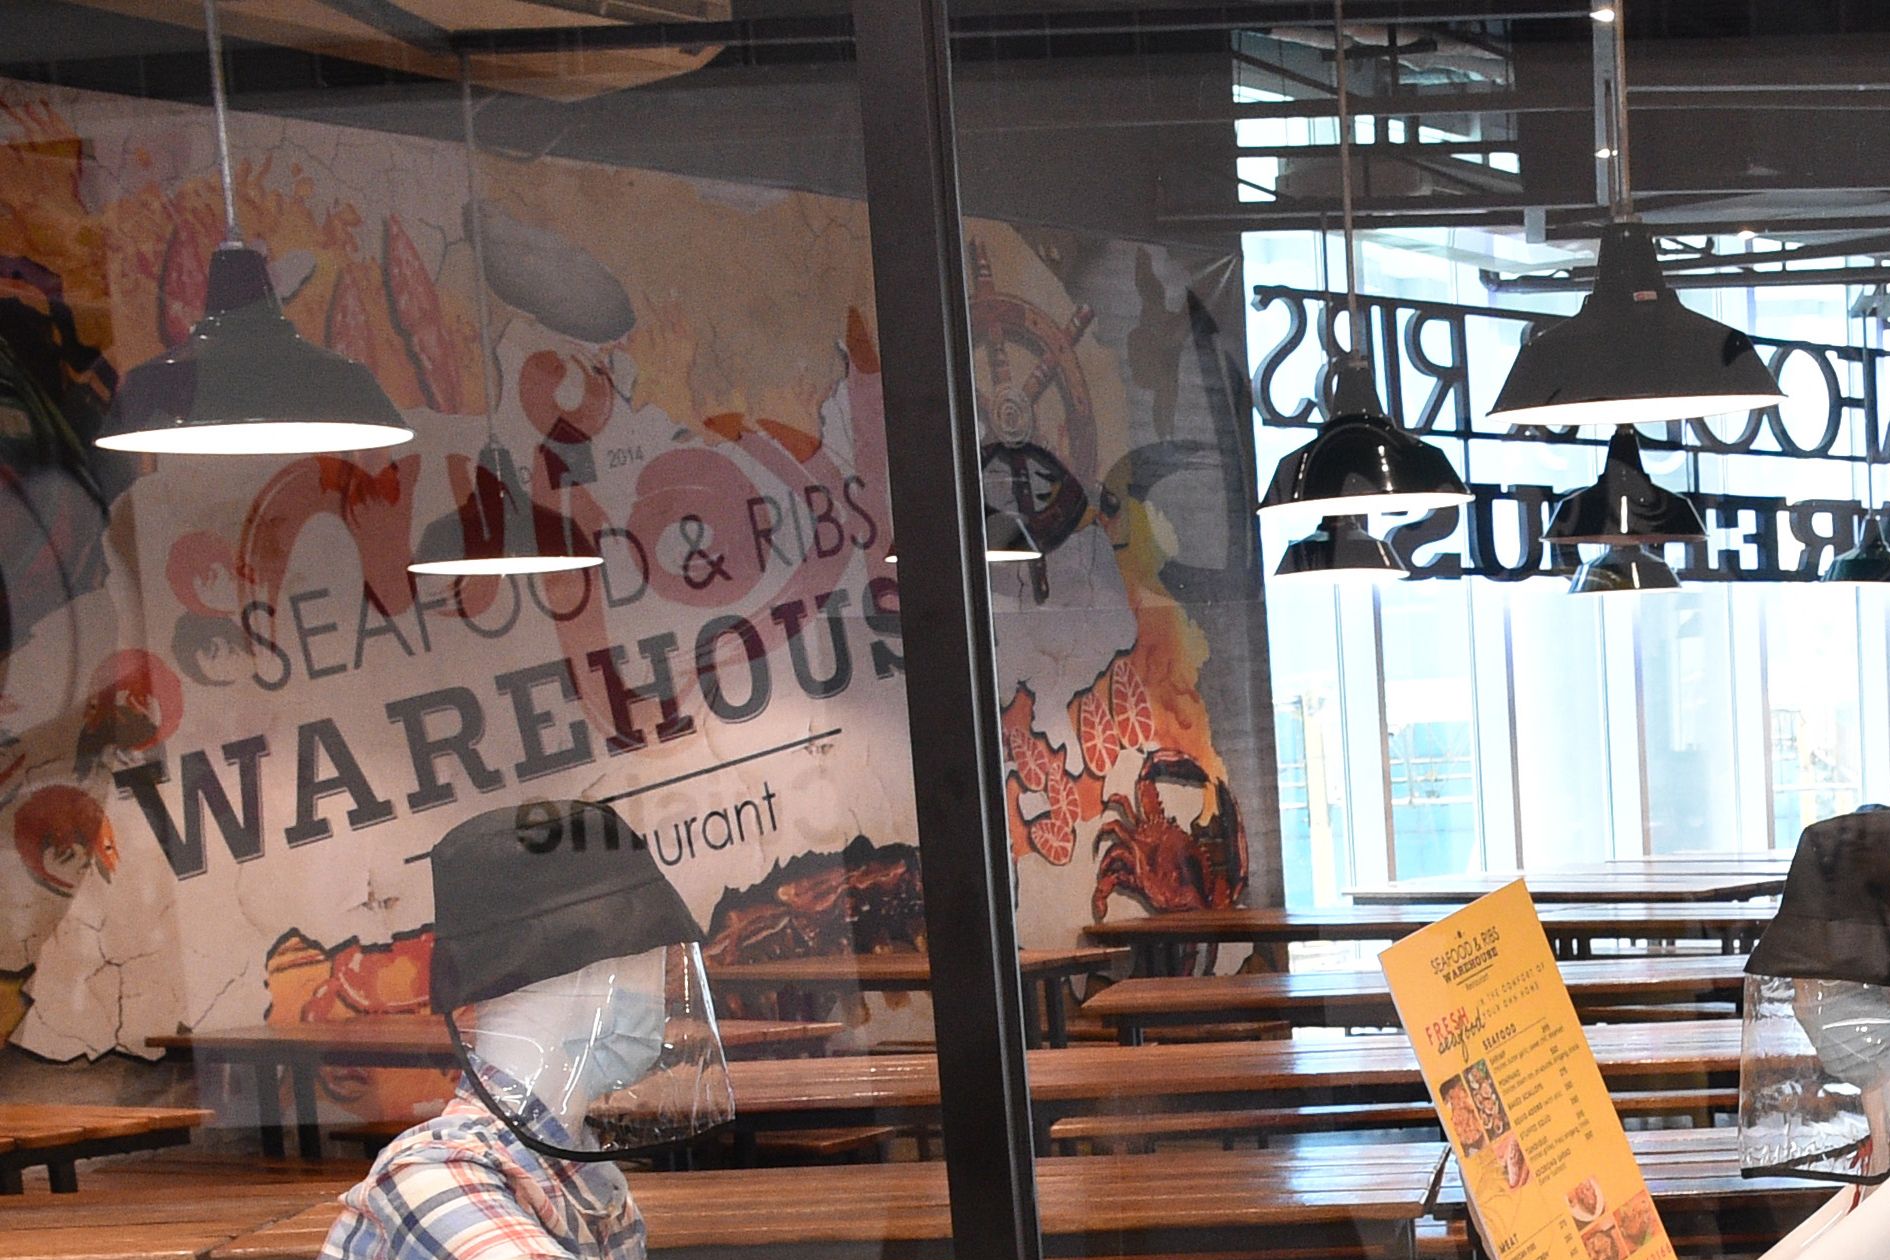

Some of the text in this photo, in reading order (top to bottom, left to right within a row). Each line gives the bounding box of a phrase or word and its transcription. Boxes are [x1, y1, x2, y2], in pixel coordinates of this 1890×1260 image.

[606, 446, 645, 469] 2014
[240, 475, 878, 692] SEAFOOD & RIBS
[114, 577, 906, 880] WAREHOUS
[646, 781, 779, 867] urant
[1430, 941, 1473, 975] SEAFOOD
[1480, 925, 1500, 945] RIBS
[1442, 946, 1499, 984] WAREHOUSE
[1425, 1006, 1470, 1046] FRESH
[1482, 1023, 1517, 1051] SEAFOOD
[1499, 1233, 1519, 1254] MEAT
